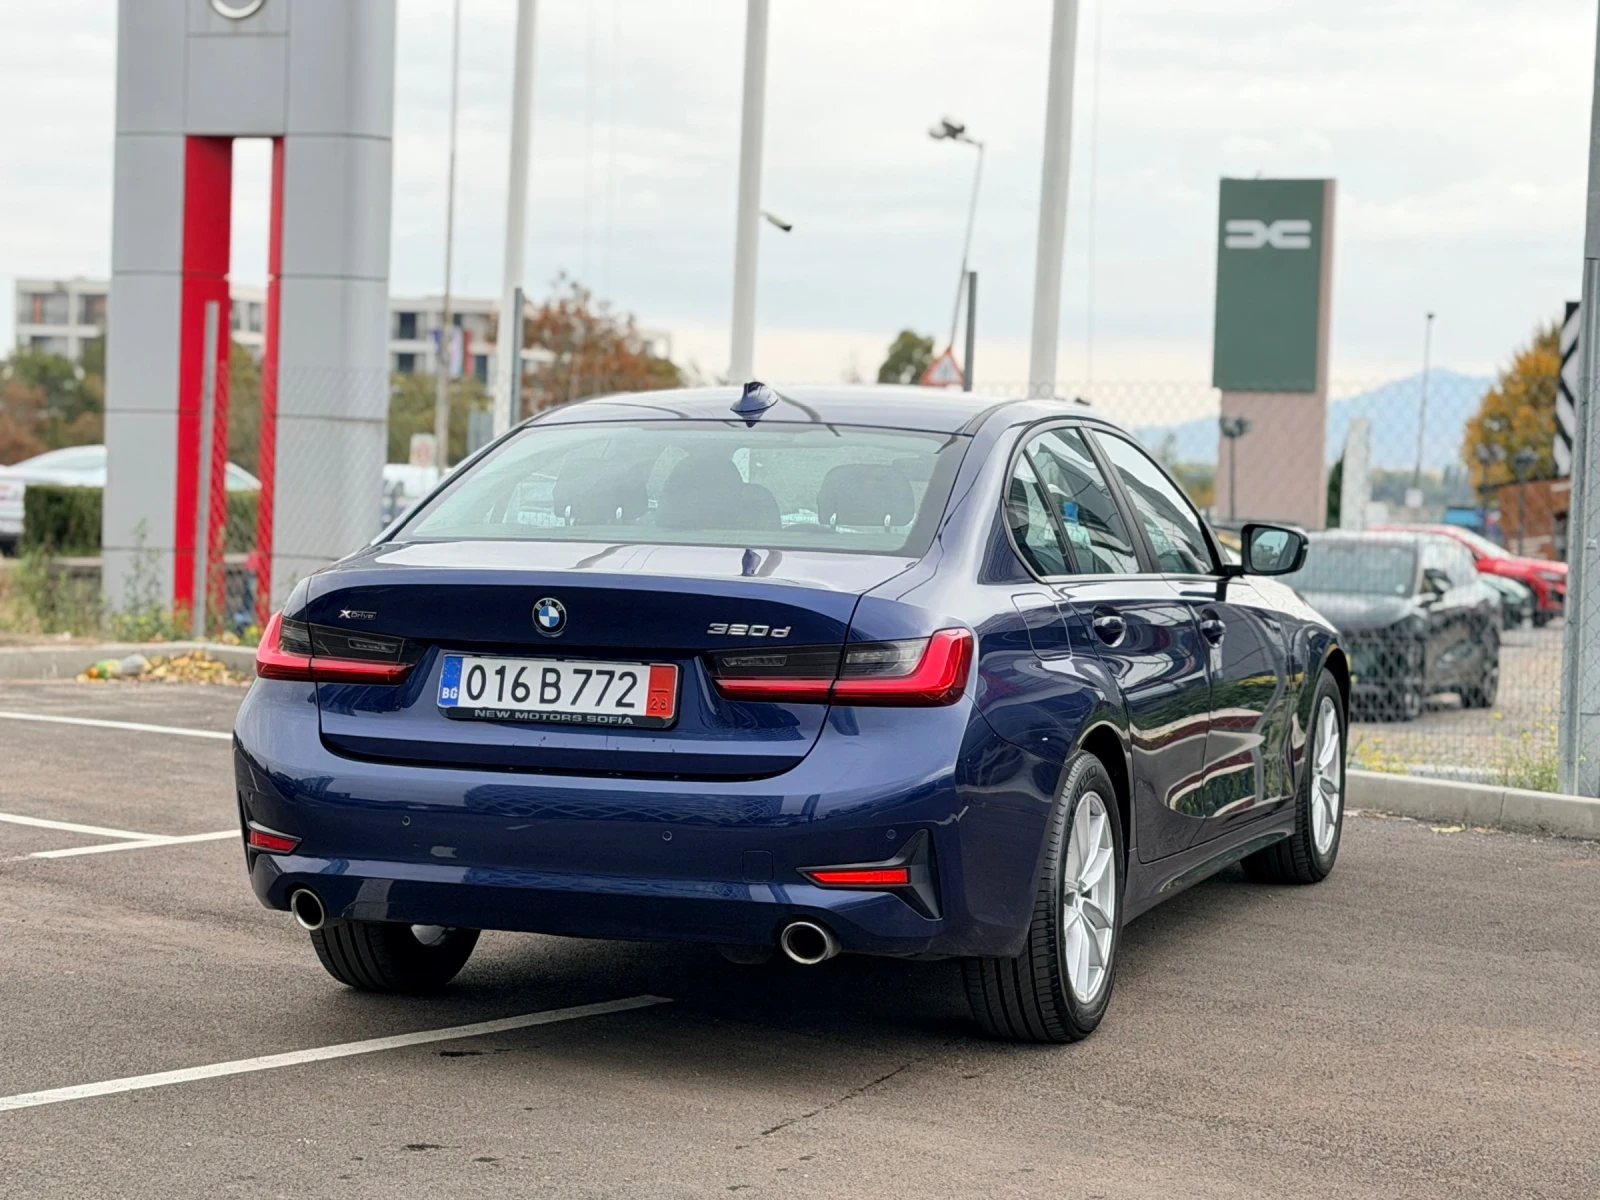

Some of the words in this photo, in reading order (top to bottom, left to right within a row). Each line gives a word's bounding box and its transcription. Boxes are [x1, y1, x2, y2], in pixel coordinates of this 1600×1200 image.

[535, 599, 563, 611] BMW
[707, 623, 792, 638] 320d
[442, 686, 458, 700] BG
[466, 664, 638, 709] 016B772
[650, 697, 667, 711] 28
[474, 709, 511, 719] NEW
[514, 712, 582, 722] MOTORS
[586, 715, 634, 725] SOFIA
